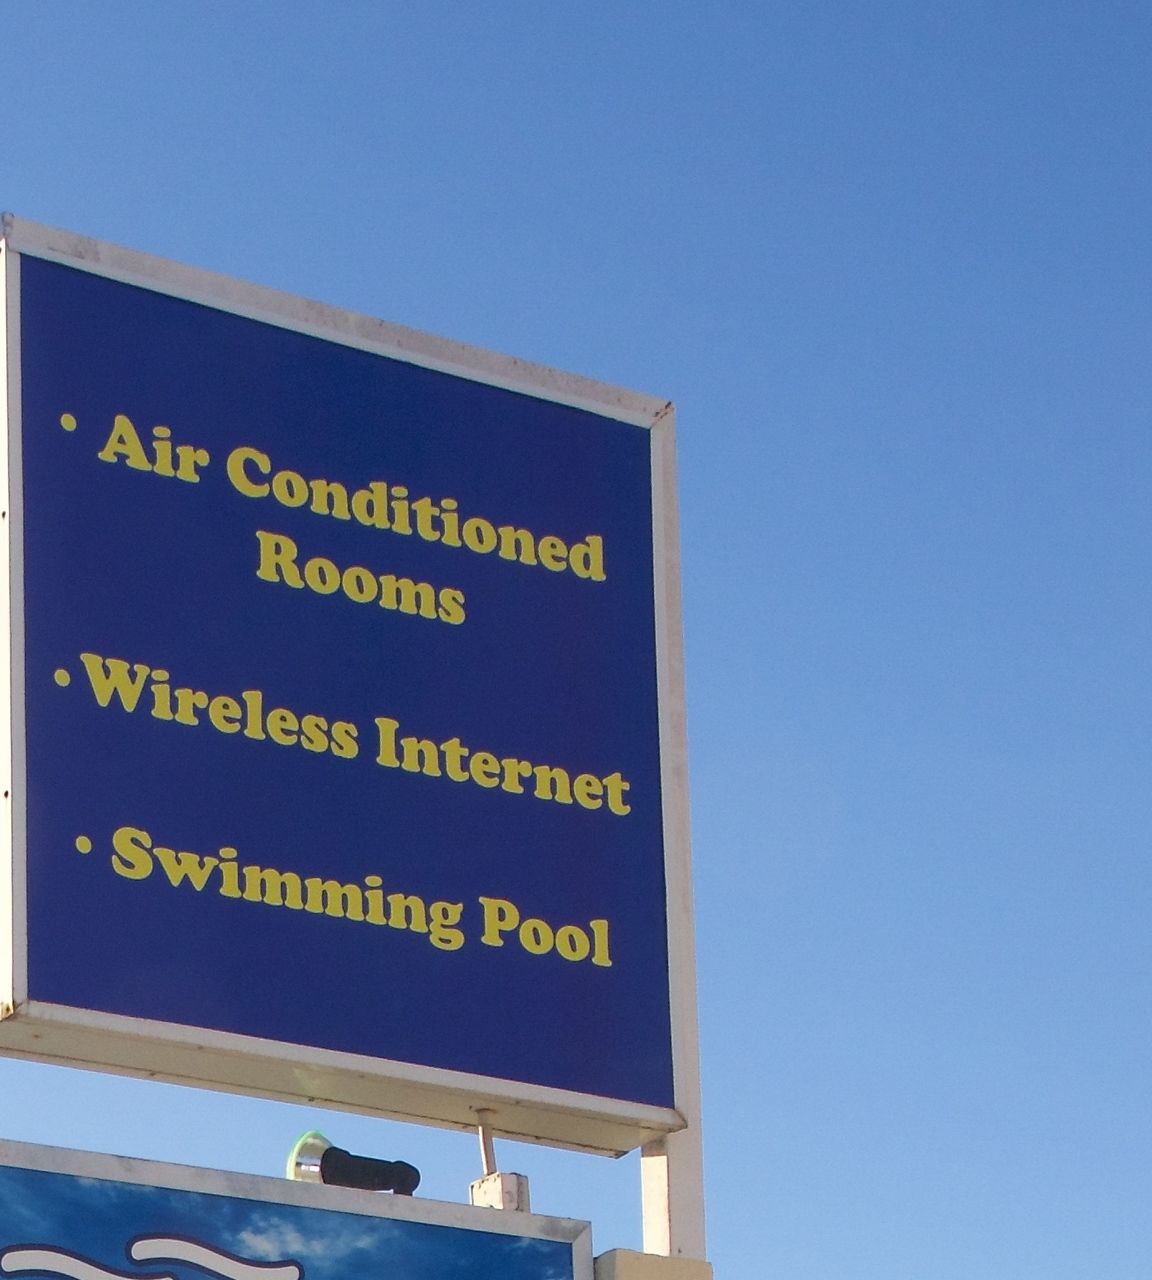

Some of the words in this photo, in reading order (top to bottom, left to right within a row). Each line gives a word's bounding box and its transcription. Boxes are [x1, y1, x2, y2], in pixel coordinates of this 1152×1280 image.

[98, 414, 210, 484] Air
[227, 446, 608, 583] Conditioned
[256, 529, 467, 627] Rooms
[80, 653, 359, 760] Wireless
[375, 717, 632, 817] Internet
[111, 826, 466, 953] Swimming
[480, 896, 613, 968] Pool
